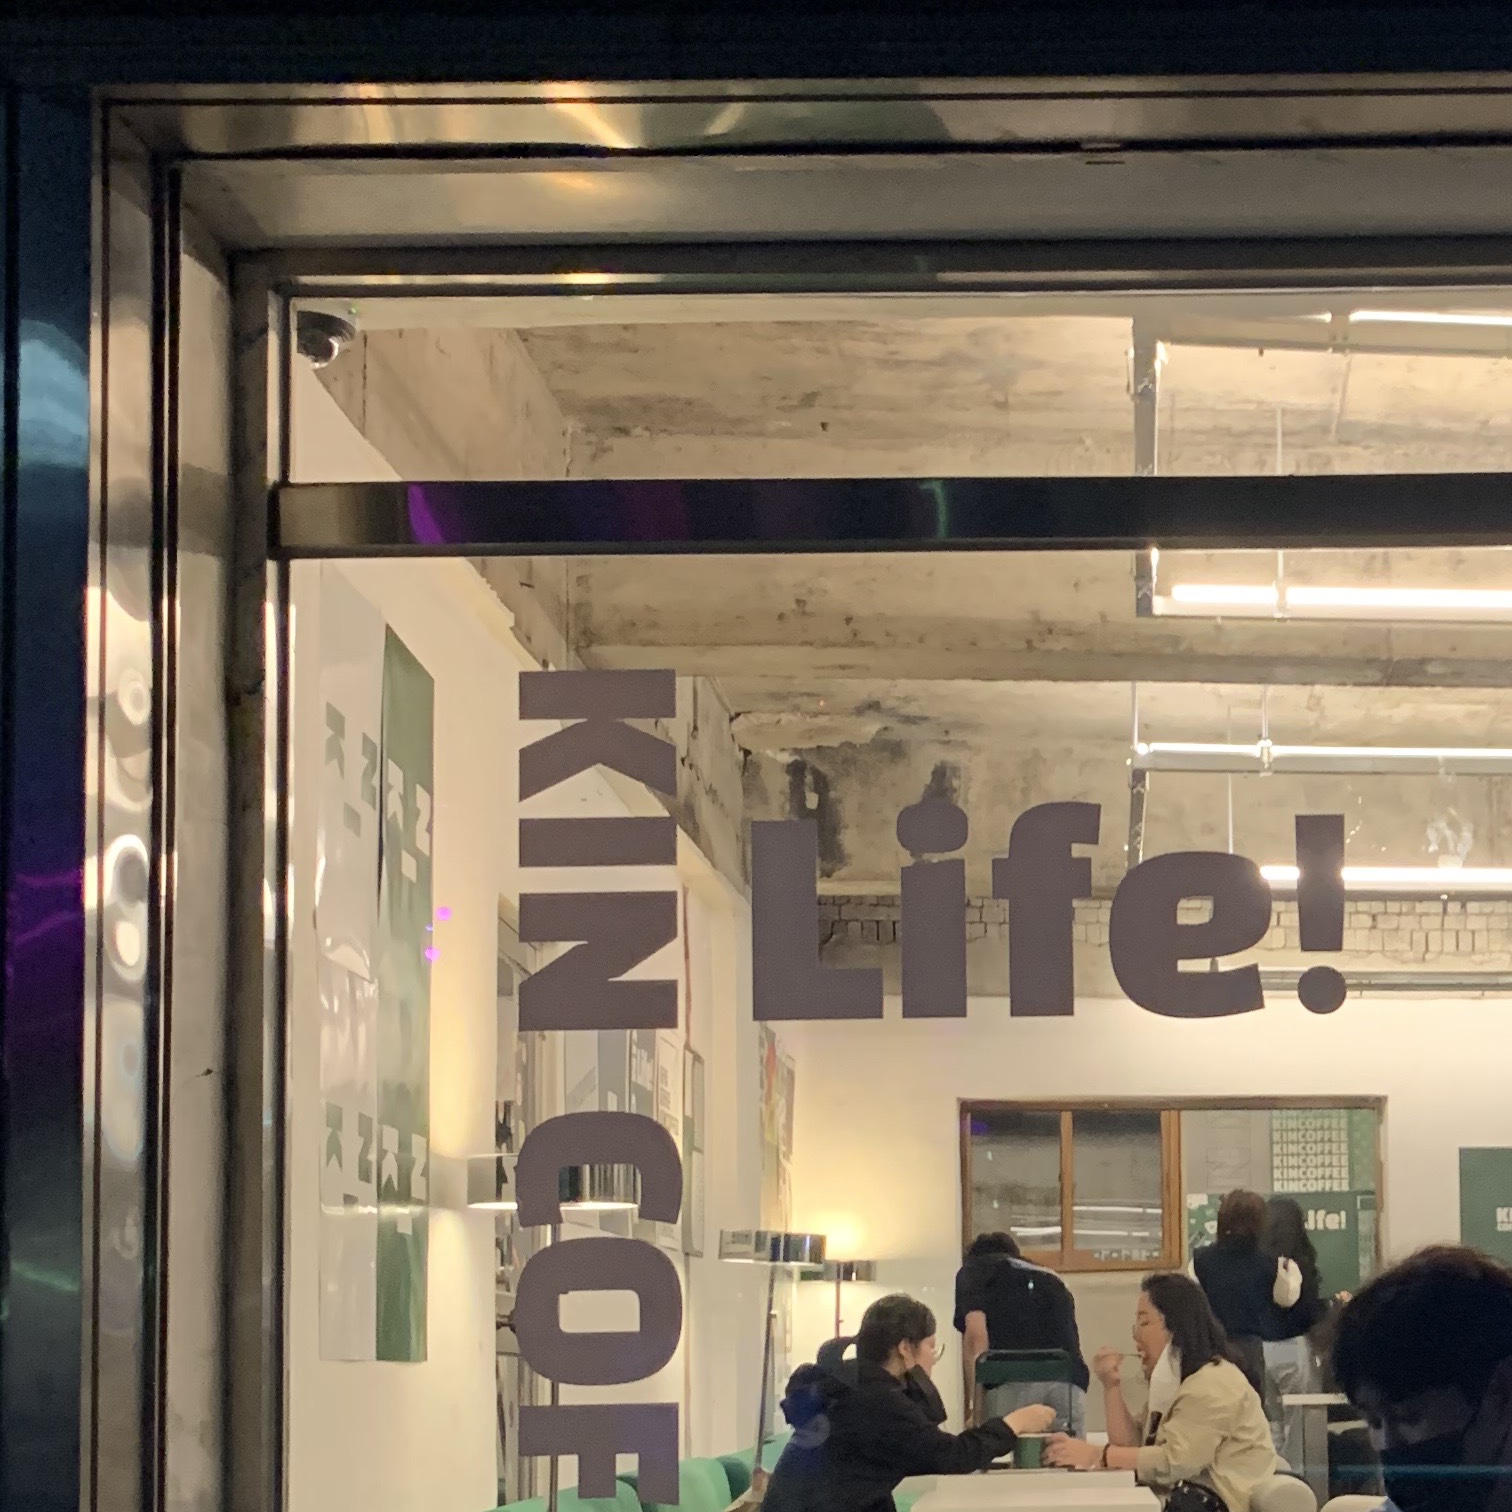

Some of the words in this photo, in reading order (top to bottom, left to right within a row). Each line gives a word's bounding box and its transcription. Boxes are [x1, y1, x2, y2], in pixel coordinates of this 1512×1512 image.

[518, 669, 678, 1030] KIN
[750, 799, 1348, 1020] Life!
[1273, 1130, 1348, 1142] KINCOFFEE
[1273, 1143, 1348, 1154] KINCOFFEE
[1273, 1156, 1348, 1167] KINCOFFEE
[1273, 1168, 1349, 1179] KINCOFFEE
[1273, 1180, 1350, 1192] KINCOFFEE
